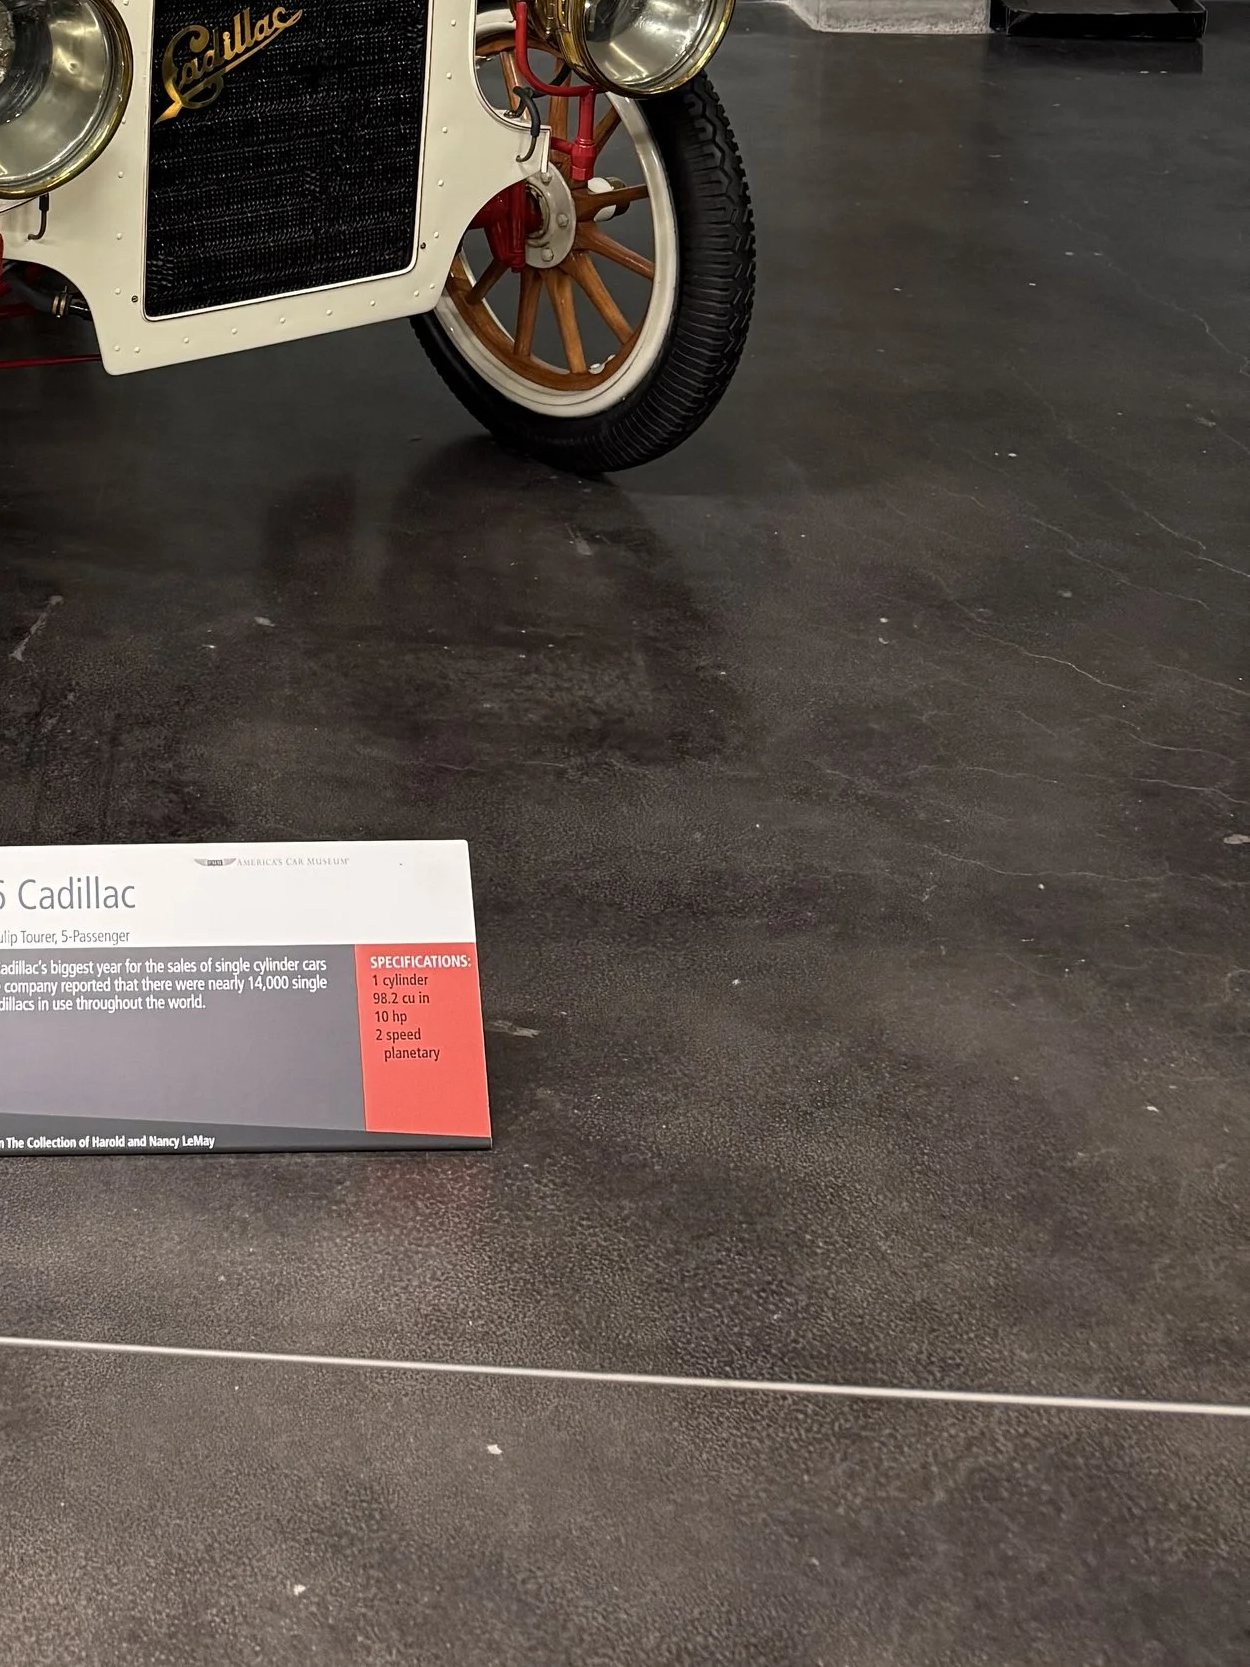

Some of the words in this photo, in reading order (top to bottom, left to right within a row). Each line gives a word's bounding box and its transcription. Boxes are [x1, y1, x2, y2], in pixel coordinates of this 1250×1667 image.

[153, 6, 304, 125] Cadillac
[17, 876, 136, 910] Cadillac
[19, 931, 58, 945] Tourer,
[61, 930, 130, 946] 5-Passenger
[50, 960, 95, 978] biggest
[97, 963, 122, 976] year
[125, 959, 142, 973] for
[145, 959, 164, 973] the
[167, 959, 198, 973] sales
[200, 959, 212, 972] of
[214, 958, 251, 976] single
[252, 958, 300, 976] cylinder
[303, 960, 326, 972] cars
[370, 955, 472, 969] SPECIFICATIONS:
[3, 982, 59, 996] company
[60, 977, 111, 996] reported
[114, 977, 138, 991] that
[140, 976, 173, 992] there
[174, 980, 206, 991] were
[207, 975, 245, 994] nearly
[247, 976, 290, 992] 14,000
[291, 975, 328, 993] single
[373, 975, 377, 986] 1
[382, 973, 429, 990] cylinder
[38, 997, 49, 1011] in
[53, 1000, 73, 1010] use
[75, 995, 144, 1014] throughout
[146, 995, 165, 1009] the
[167, 995, 206, 1010] world.
[373, 992, 398, 1004] 98.2
[402, 995, 415, 1003] cu
[419, 991, 429, 1003] in
[375, 1011, 388, 1022] 10
[393, 1010, 407, 1025] hp
[376, 1029, 382, 1040] 2
[386, 1028, 422, 1045] speed
[384, 1046, 441, 1063] planetary
[6, 1137, 24, 1148] The
[26, 1136, 77, 1149] Collection
[79, 1136, 89, 1148] of
[91, 1135, 126, 1148] Harold
[128, 1135, 146, 1147] and
[148, 1136, 180, 1150] Nancy
[181, 1135, 216, 1150] LeMay
